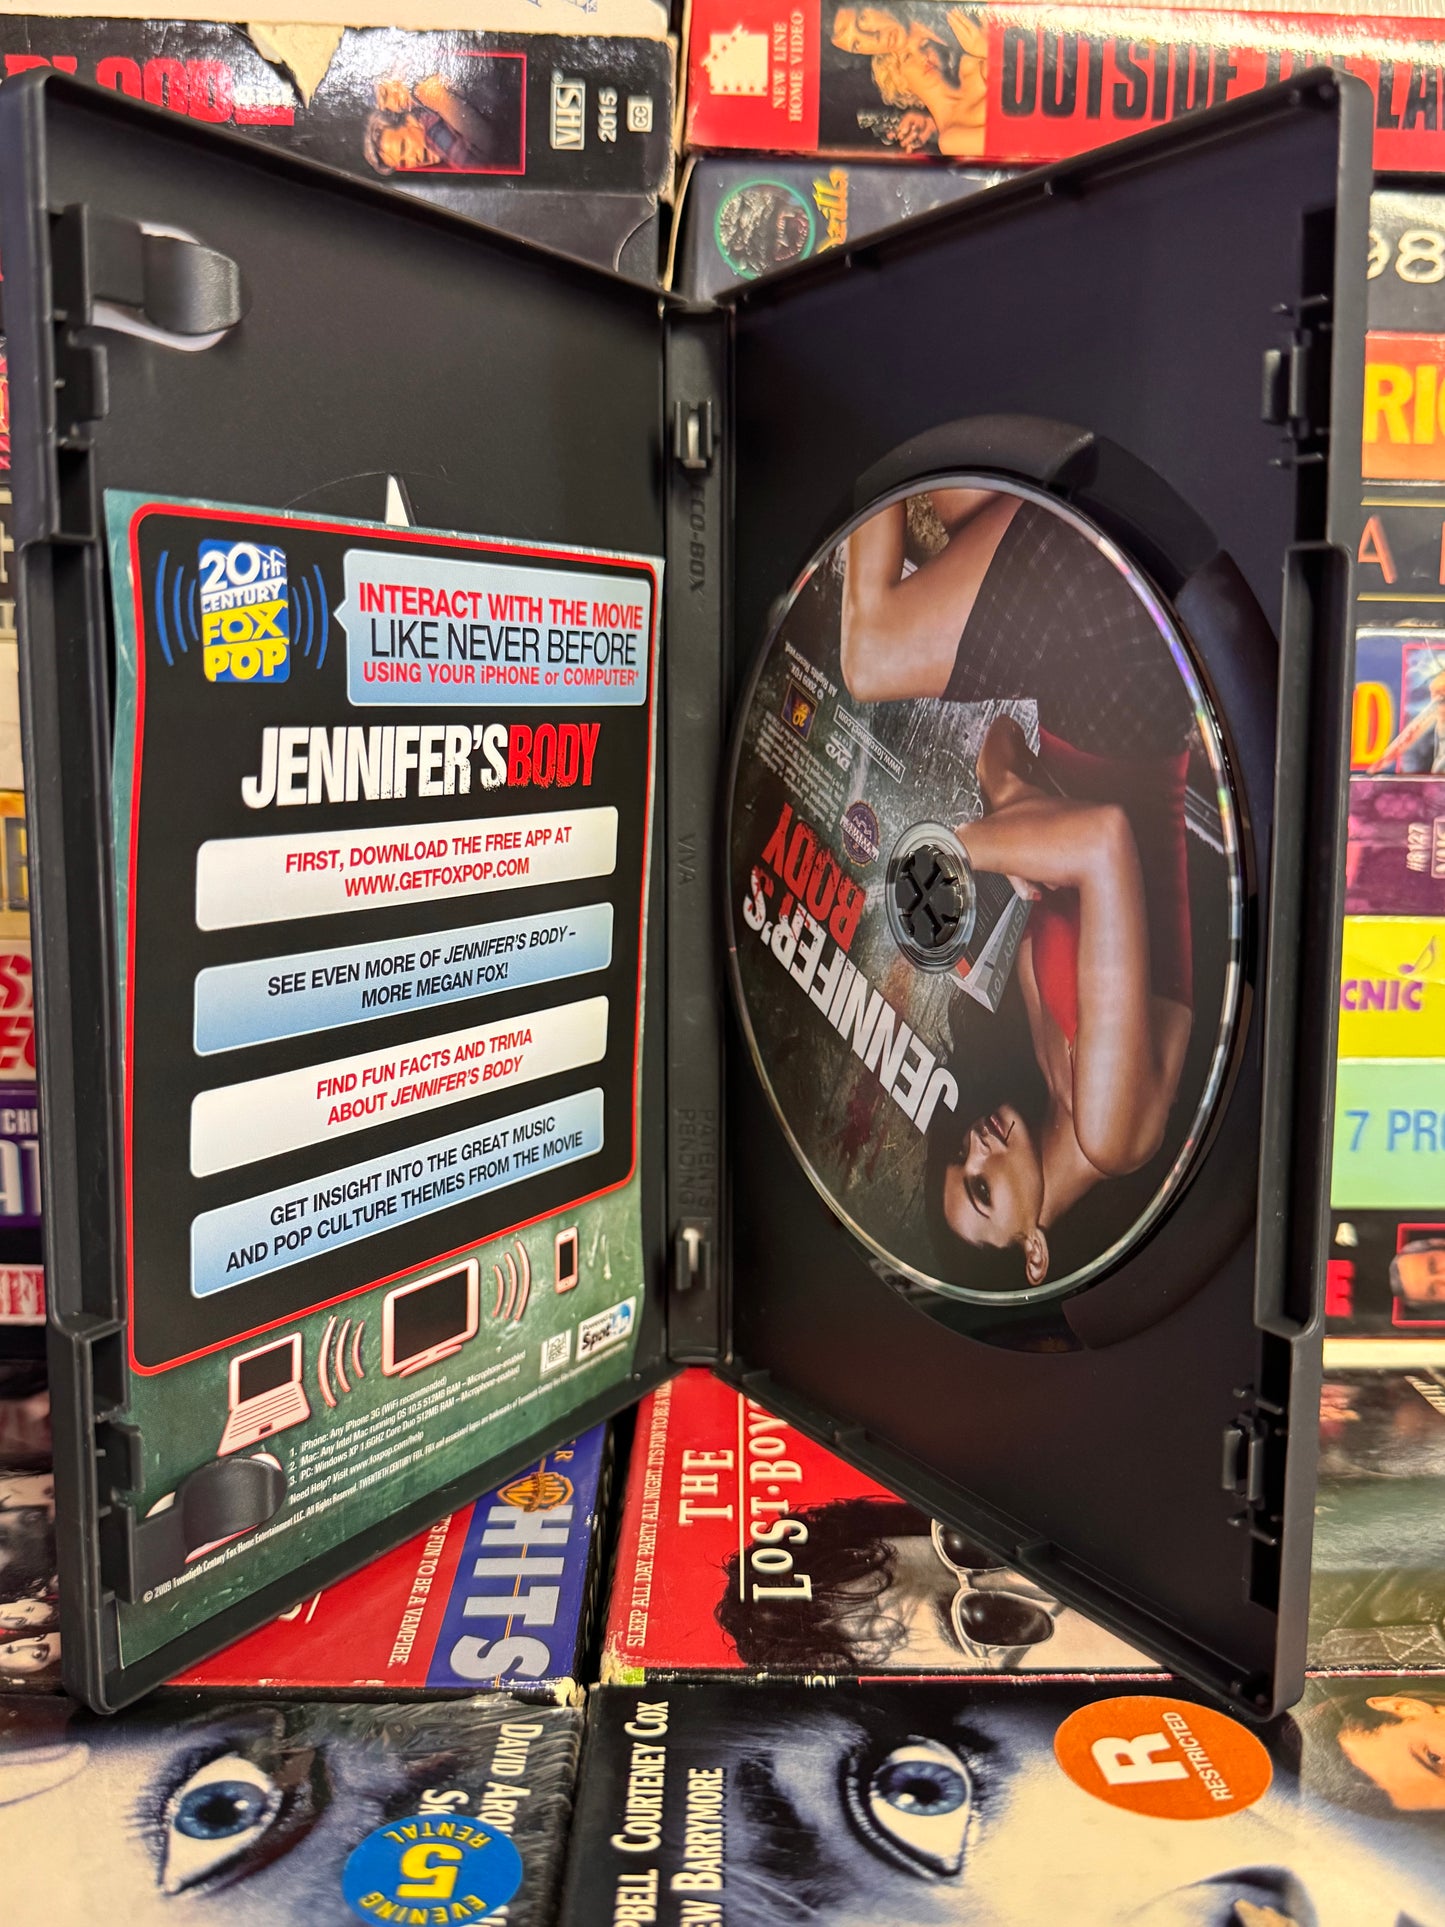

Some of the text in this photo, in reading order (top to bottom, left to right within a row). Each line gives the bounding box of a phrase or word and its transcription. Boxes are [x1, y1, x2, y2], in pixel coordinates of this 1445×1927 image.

[773, 21, 788, 109] NEW LINE
[789, 11, 804, 122] HOME VIDEO
[554, 84, 583, 148] VHS
[598, 87, 617, 142] 2015
[633, 106, 648, 129] CC
[1363, 363, 1445, 444] RI
[201, 582, 284, 613] CENTURY
[203, 601, 287, 646] FOX
[359, 582, 643, 630] INTERACT WITH THE MOVIE
[204, 640, 288, 681] POP
[371, 618, 637, 665] LIKE NEVER BEFORE
[363, 661, 422, 683] USING
[427, 664, 476, 684] YOUR
[480, 665, 540, 685] iPHONE
[544, 672, 559, 685] or
[241, 723, 601, 809] JENNIFER'S BODY
[825, 742, 850, 772] DVD
[285, 827, 572, 874] FIRST, DOWNLOAD THE FREE APP AT
[345, 857, 530, 897] WWW.GETFOXPOP.COM
[761, 802, 866, 953] BODY
[268, 926, 568, 996] SEE EVEN MORE OF JENNIFER'S BODY
[361, 962, 509, 1009] MORE MEGAN FOX!
[743, 865, 959, 1135] JENNIFER'S
[316, 1029, 533, 1100] FIND FUN FACTS AND TRIVIA
[327, 1055, 524, 1126] ABOUT JENNIFER'S BODY
[1387, 1110, 1445, 1151] PR
[269, 1117, 556, 1227] GET INSIGHT INTO THE GREAT MUSIC
[226, 1131, 584, 1273] AND POP CULTURE THEMES FROM THE MOVIE
[300, 1452, 320, 1466] Mac:
[320, 1444, 335, 1457] Any
[336, 1435, 352, 1450] Intel
[352, 1428, 369, 1441] Mac
[369, 1415, 396, 1435] running
[397, 1408, 407, 1419] OS
[446, 1381, 461, 1396] RAM
[300, 1467, 313, 1481] PC:
[314, 1450, 348, 1474] Windows
[348, 1444, 359, 1457] XP
[385, 1425, 401, 1439] Core
[402, 1418, 416, 1432] Duo
[439, 1396, 455, 1412] RAM
[301, 1434, 329, 1453] iPhone:
[330, 1426, 344, 1440] Any
[345, 1415, 370, 1432] iPhone
[370, 1407, 381, 1420] 3G
[289, 1487, 310, 1505] Need
[310, 1476, 332, 1494] Help?
[332, 1468, 349, 1484] Visit
[641, 1500, 659, 1522] ALL
[679, 1449, 734, 1526] THE
[637, 1522, 657, 1558] PARTY
[750, 1496, 812, 1603] LOST
[153, 1580, 172, 1599] 2009
[226, 1548, 237, 1561] Fox
[450, 1504, 574, 1680] HITS
[632, 1584, 651, 1609] ALL
[387, 1535, 446, 1669] FUN TO BE A VAMPIRE.
[626, 1609, 648, 1648] SLEEP
[491, 1723, 543, 1777] DAVID
[1091, 1732, 1190, 1785] R
[1162, 1712, 1234, 1801] RESTRICTED
[382, 1822, 492, 1848] RENTAL
[396, 1843, 463, 1899] 5
[358, 1891, 487, 1925] EVENING
